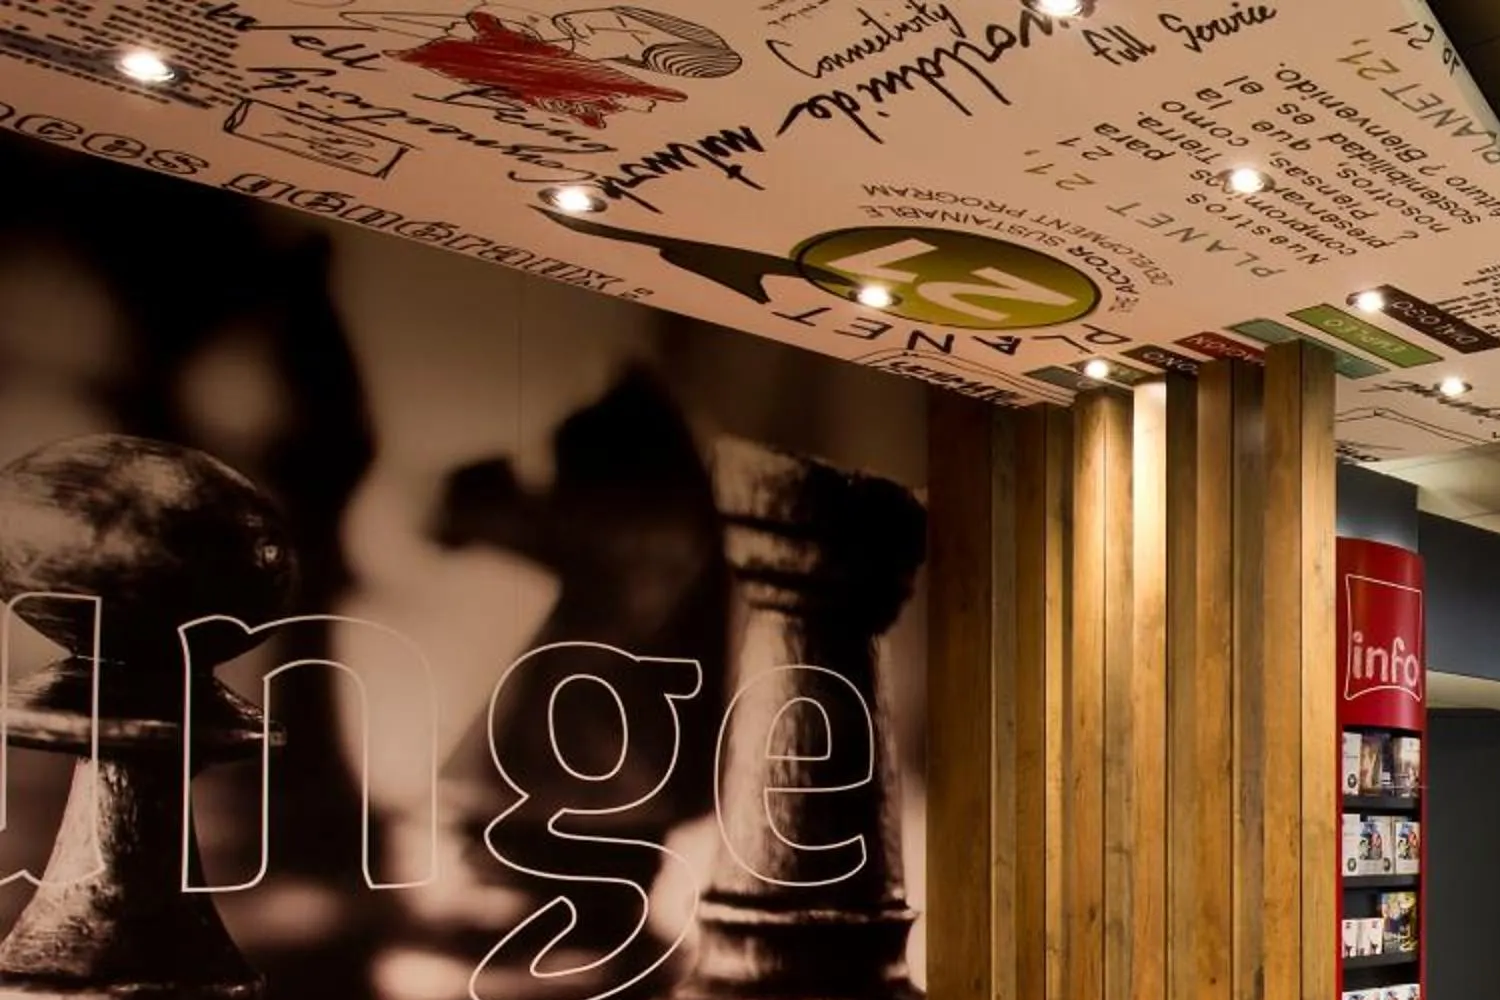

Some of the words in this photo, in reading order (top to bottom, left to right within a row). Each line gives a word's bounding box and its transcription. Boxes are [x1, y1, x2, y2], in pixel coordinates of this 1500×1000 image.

[765, 0, 967, 79] Connectivity
[1195, 86, 1234, 111] la
[1222, 74, 1265, 97] el
[1160, 99, 1251, 148] como
[1250, 119, 1313, 153] que
[1275, 101, 1316, 126] es
[1093, 121, 1177, 162] para
[862, 183, 1027, 219] PROGRAM
[1318, 131, 1482, 226] sostenibilidad
[858, 203, 1068, 249] SUSTAINABLE
[1105, 202, 1287, 277] PLANET
[1186, 192, 1331, 265] Nuestros
[1273, 184, 1397, 250] preservar
[826, 237, 1078, 323] 21
[1066, 245, 1140, 296] ACCOR
[771, 306, 1132, 356] PLANET
[1352, 631, 1419, 687] info
